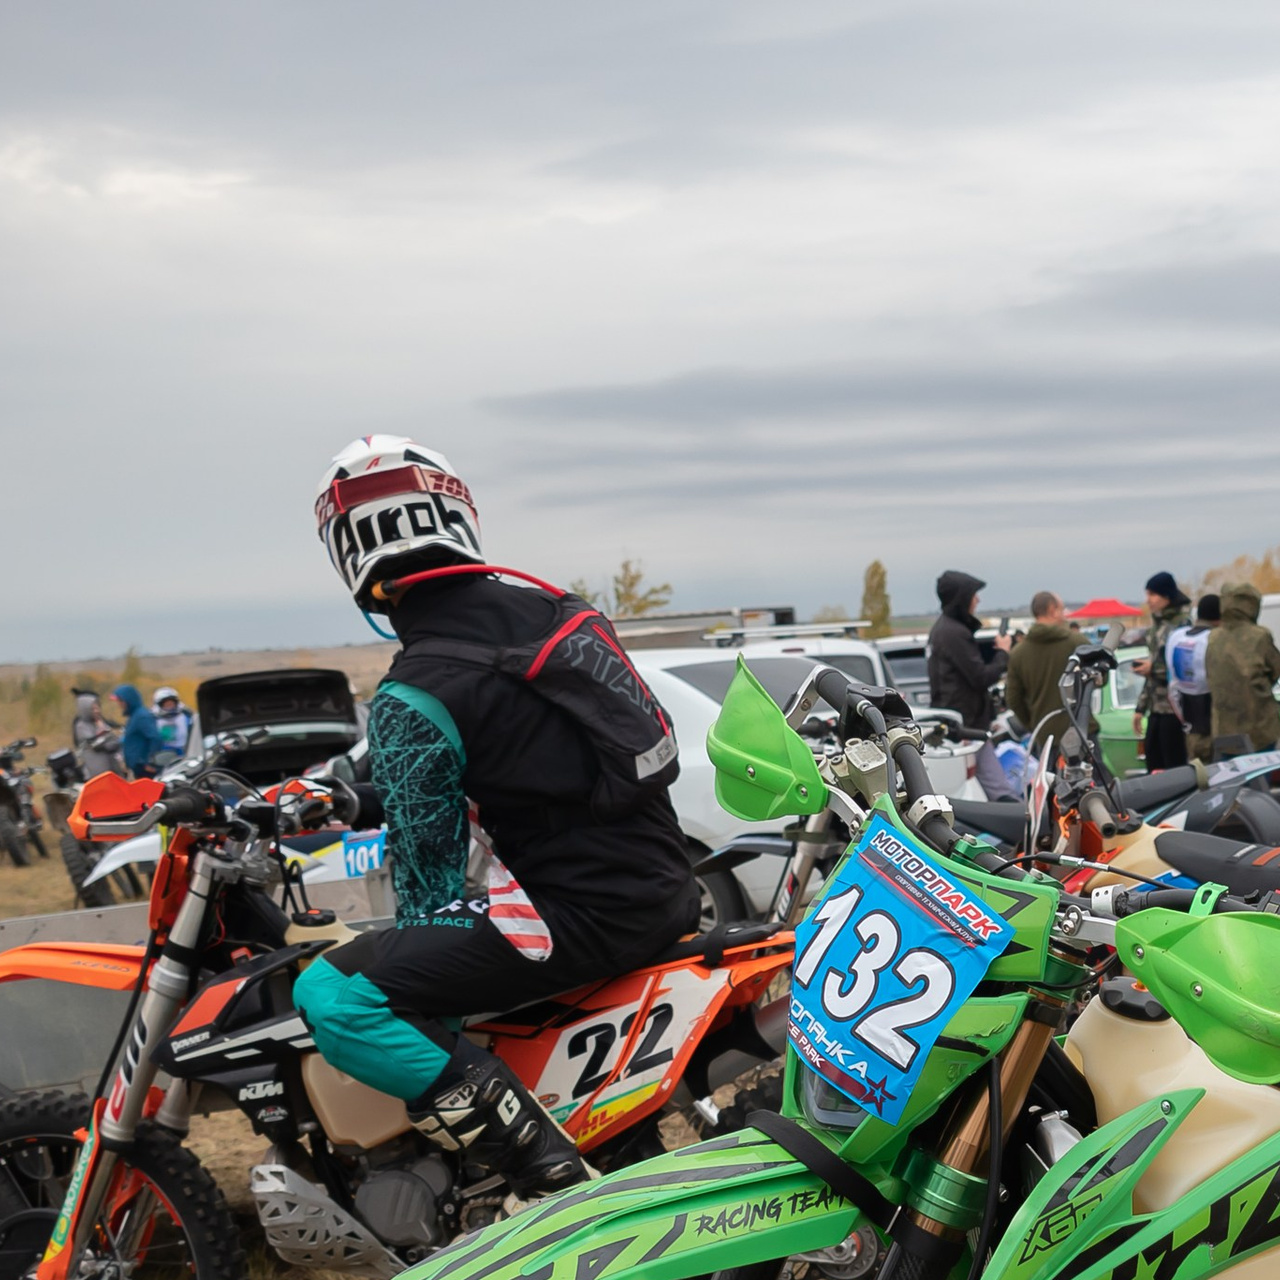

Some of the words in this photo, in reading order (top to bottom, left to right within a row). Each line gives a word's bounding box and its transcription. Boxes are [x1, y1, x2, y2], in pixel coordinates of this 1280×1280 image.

[345, 842, 381, 875] 101
[869, 828, 1003, 941] МОТОРПАРК
[432, 916, 475, 929] RACE
[795, 883, 956, 1074] 132
[567, 1003, 674, 1101] 22
[798, 1034, 826, 1069] PARK
[239, 1081, 284, 1101] KTM
[692, 1197, 784, 1238] RACING
